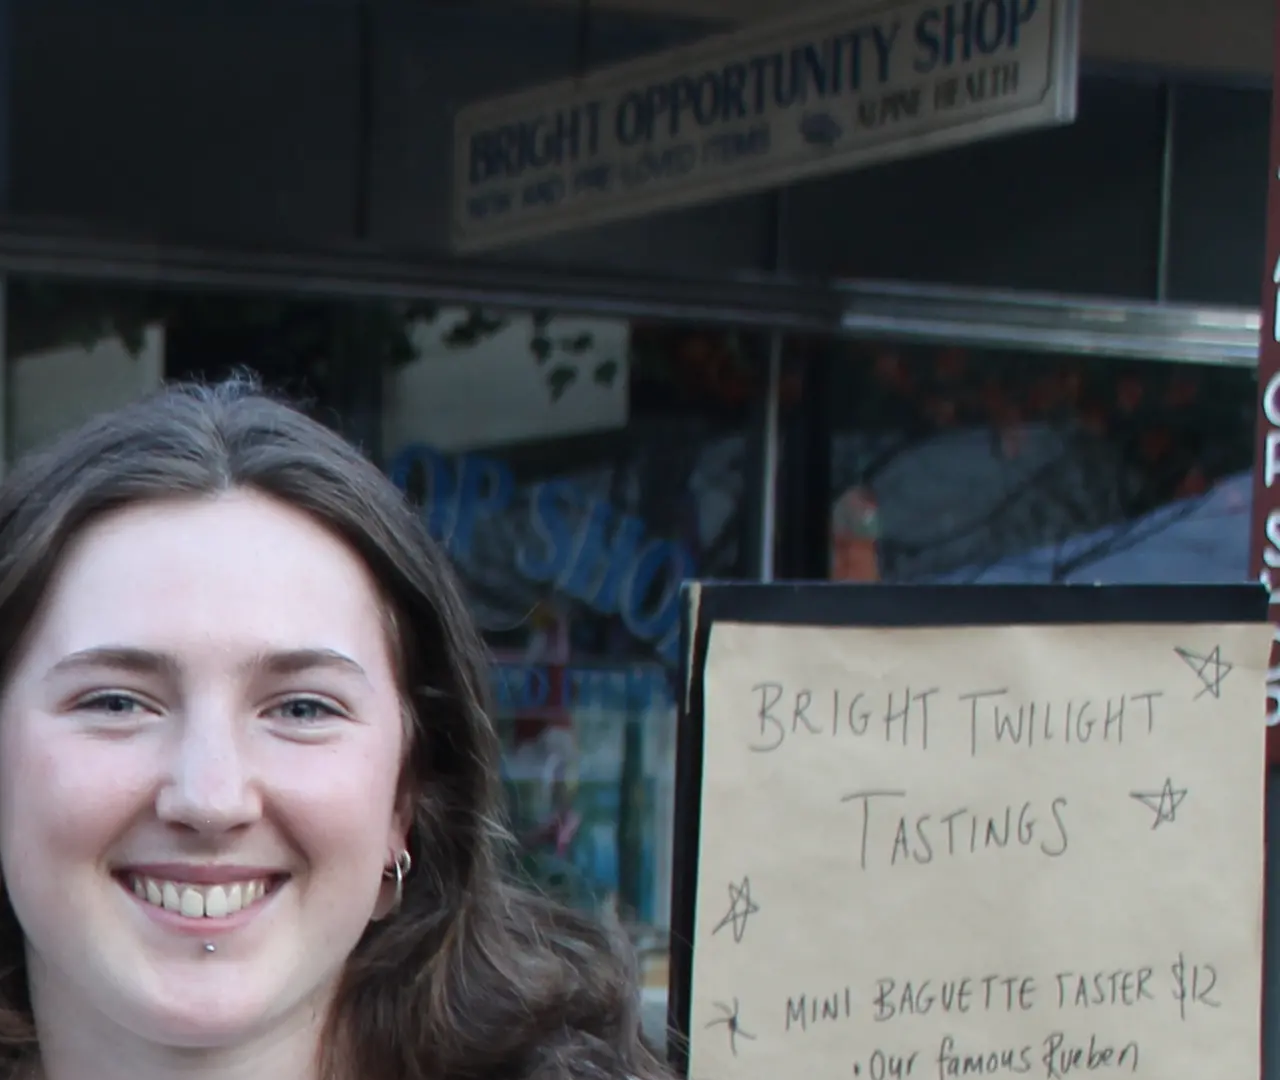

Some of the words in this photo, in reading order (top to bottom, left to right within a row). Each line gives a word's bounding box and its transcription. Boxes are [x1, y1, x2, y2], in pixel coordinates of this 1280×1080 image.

[468, 100, 602, 186] BRIGHT
[615, 18, 903, 147] OPPORTUNITY
[912, 0, 1038, 73] SHOP
[933, 60, 1021, 111] HEALTH
[515, 477, 698, 664] SHO
[747, 681, 941, 752] BRIGHT
[959, 686, 1165, 757] TWILIGHT
[840, 790, 1070, 870] TASTINGS
[783, 987, 852, 1032] MINI
[872, 975, 1037, 1023] BAGUETTE
[1055, 967, 1155, 1010] TASTER
[1171, 951, 1222, 1021] $12
